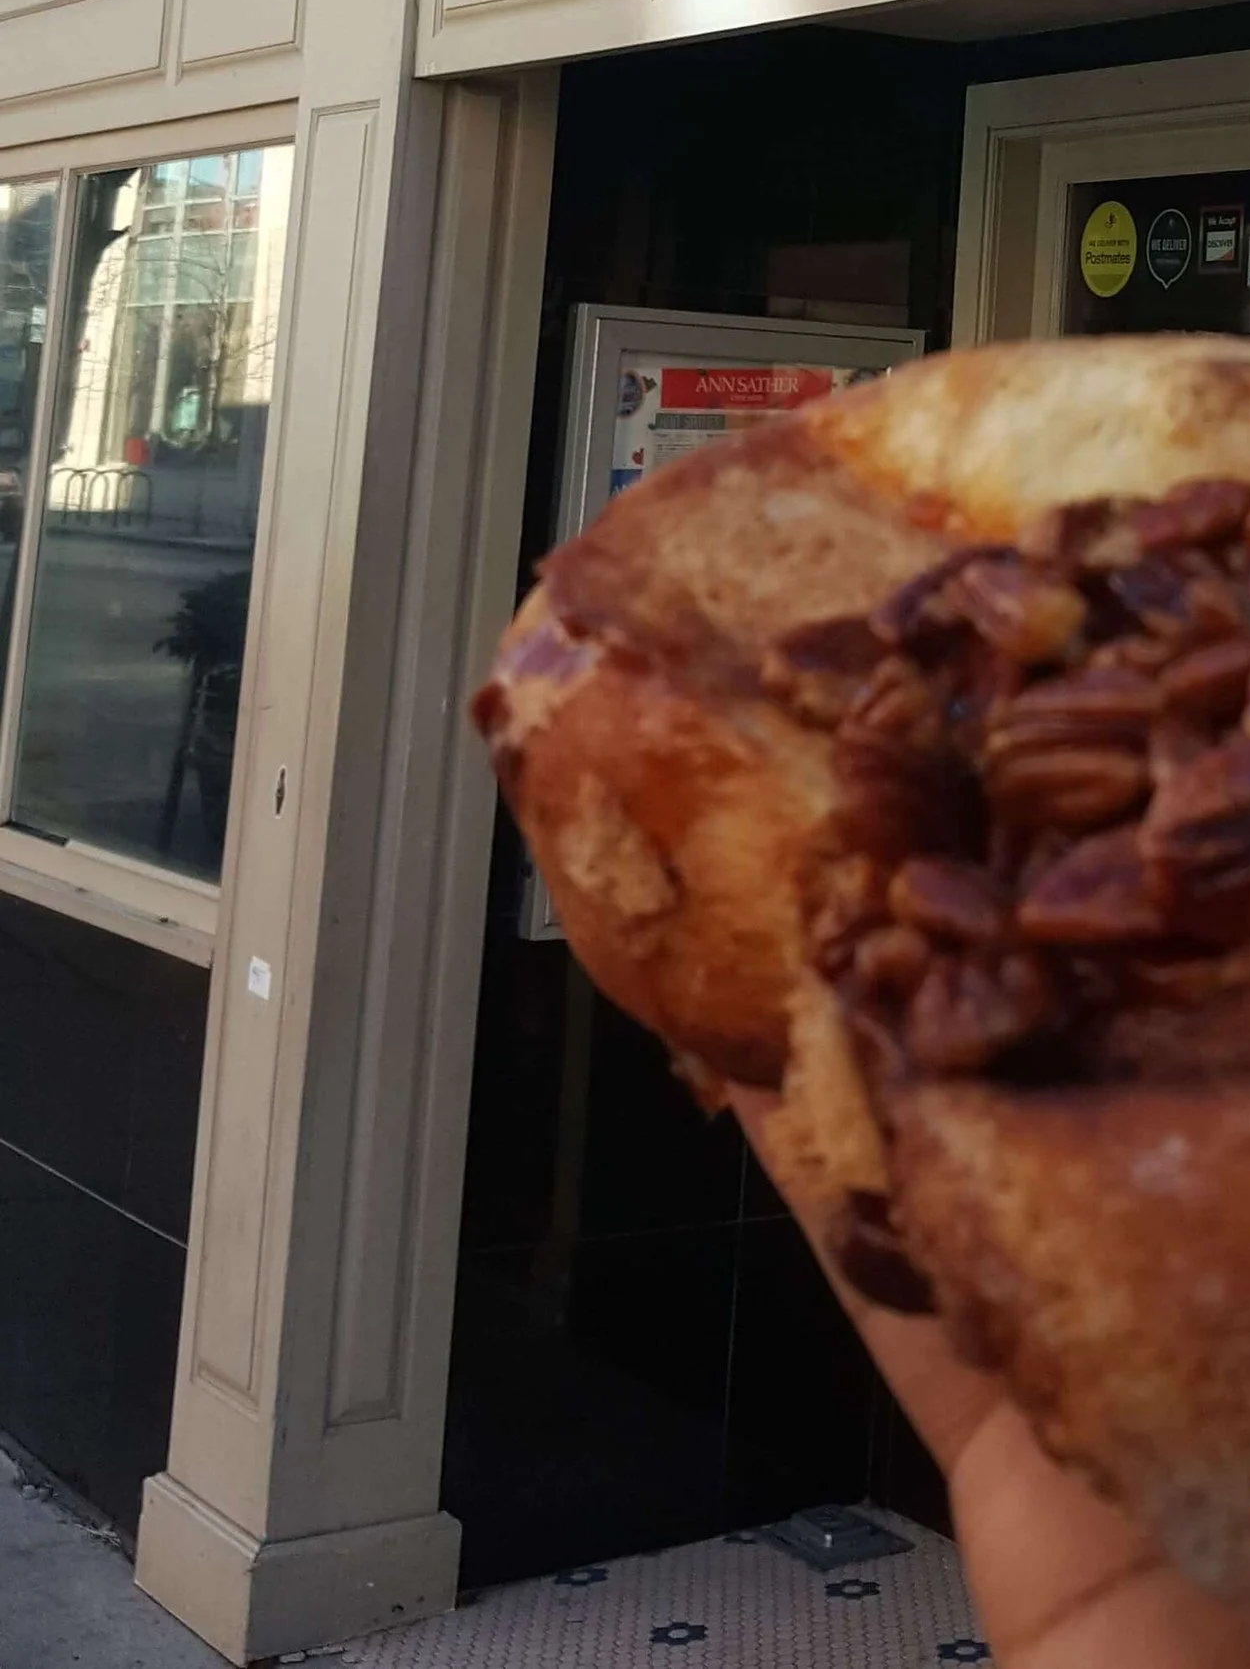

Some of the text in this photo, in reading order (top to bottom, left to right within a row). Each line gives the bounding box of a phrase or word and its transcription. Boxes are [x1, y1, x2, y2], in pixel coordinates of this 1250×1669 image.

[1085, 251, 1132, 265] Postmates
[695, 376, 800, 394] ANN SATHER
